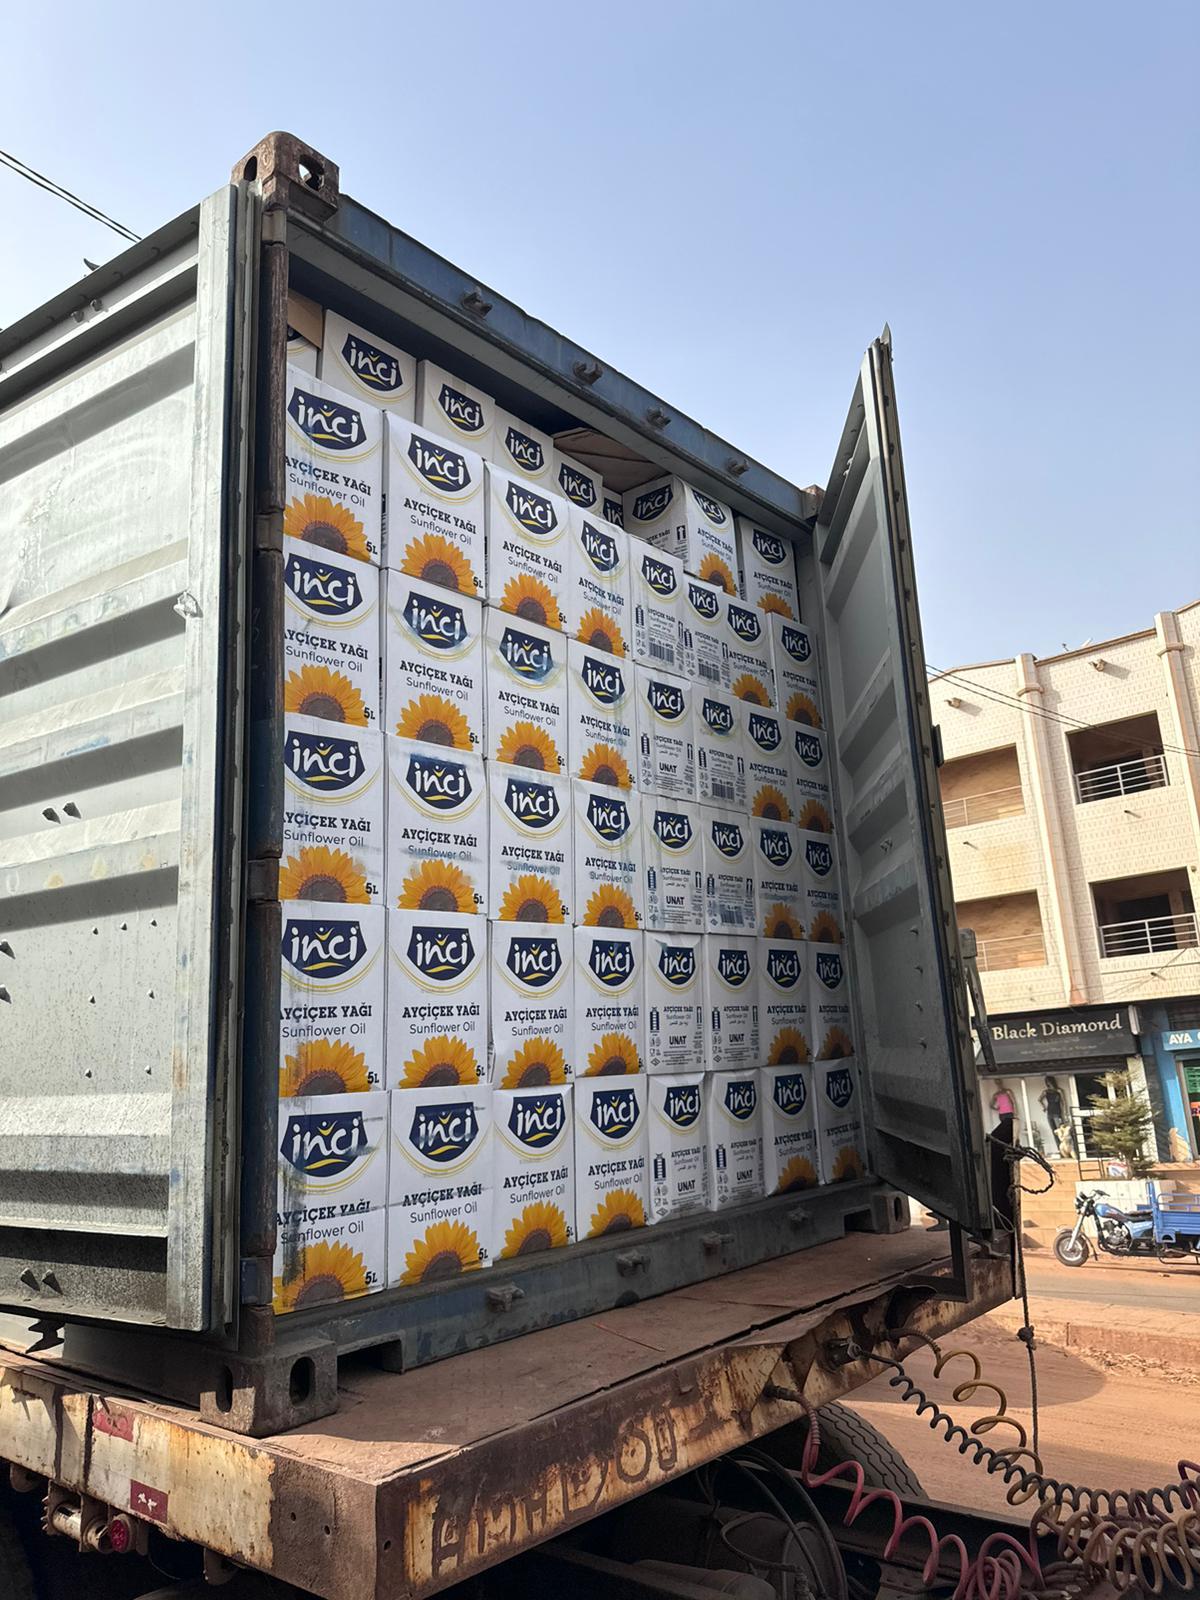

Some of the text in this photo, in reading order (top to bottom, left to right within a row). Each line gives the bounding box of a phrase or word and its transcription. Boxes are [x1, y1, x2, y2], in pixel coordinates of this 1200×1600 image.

[350, 341, 396, 386] inci
[298, 396, 359, 443] inci
[444, 390, 479, 427] inci
[510, 433, 540, 466] inci
[416, 441, 464, 484] inci
[290, 473, 365, 507] Sunflower Oil
[343, 477, 371, 496] YAĞI
[563, 469, 593, 502] inci
[404, 498, 476, 534] AYÇİÇEK YAĞI
[512, 488, 552, 527] inci
[411, 514, 471, 545] Sunflower Oil
[366, 541, 377, 554] 5L
[503, 541, 562, 573] AYÇİÇEK YAĞI
[585, 528, 614, 568] inci
[508, 556, 558, 583] Sunflower Oil
[646, 562, 674, 590] inci
[293, 561, 354, 606] inci
[473, 577, 483, 588] 5L
[692, 584, 716, 613] inci
[412, 599, 461, 640] inci
[559, 613, 567, 623] 5L
[731, 608, 759, 637] inci
[340, 640, 368, 659] YAĞI
[507, 635, 547, 670] inci
[784, 631, 809, 656] inci
[285, 645, 362, 672] Sunflower Oil
[400, 660, 473, 689] AYÇİÇEK YAĞI
[587, 663, 619, 695] inci
[407, 677, 468, 700] Sunflower Oil
[652, 688, 681, 712] inci
[364, 708, 375, 720] 5L
[498, 691, 559, 715] AYÇİÇEK YAĞI
[504, 706, 556, 727] Sunflower Oil
[580, 715, 611, 732] AYÇİÇEK
[705, 703, 730, 727] inci
[469, 733, 479, 744] 5L
[586, 729, 616, 745] Sunflower
[752, 718, 777, 742] inci
[293, 739, 357, 777] inci
[797, 736, 820, 759] inci
[415, 762, 464, 797] inci
[511, 785, 553, 816] inci
[284, 811, 370, 832] YÇİÇEK YAĞI
[593, 801, 625, 830] inci
[284, 829, 364, 847] Sunflower Oil
[402, 828, 477, 847] AYÇİÇEK YAĞI
[658, 816, 688, 839] inci
[714, 827, 740, 849] inci
[459, 850, 471, 860] Oil
[502, 846, 564, 862] AYÇİÇEK YAĞI
[763, 835, 788, 857] inci
[809, 845, 830, 866] inci
[585, 857, 617, 872] AYÇİÇEK
[366, 883, 378, 894] 5L
[473, 894, 483, 904] 5L
[562, 906, 569, 915] 5L
[291, 926, 358, 963] inci
[416, 933, 467, 966] inci
[514, 943, 556, 974] inci
[596, 946, 629, 974] inci
[664, 952, 692, 974] inci
[722, 954, 747, 975] inci
[771, 954, 797, 977] inci
[819, 957, 841, 978] inci
[342, 1002, 372, 1017] YAĞI
[402, 1003, 480, 1021] AYÇİÇEK YAĞI
[505, 1006, 567, 1024] AYÇİÇEK YAĞI
[586, 1004, 639, 1020] AYÇİÇEK YAĞI
[282, 1024, 365, 1037] Sunflower Oil
[410, 1022, 475, 1034] Sunflower Oil
[512, 1024, 563, 1036] Sunflower Oil
[592, 1021, 636, 1031] Sunflower Oil
[992, 1013, 1122, 1041] Black Diamond
[669, 1036, 686, 1045] UNAT
[1169, 1033, 1193, 1044] AYA
[367, 1072, 379, 1084] 5L
[476, 1065, 485, 1076] 5L
[564, 1064, 572, 1074] 5L
[670, 1088, 699, 1117] inci
[730, 1084, 754, 1111] inci
[777, 1077, 804, 1105] inci
[518, 1100, 561, 1136] inci
[596, 1093, 634, 1127] inci
[292, 1117, 359, 1163] inci
[419, 1108, 471, 1150] inci
[504, 1166, 568, 1188] AYÇİÇEK YAĞI
[588, 1156, 644, 1176] AYÇİÇEK YAĞI
[595, 1173, 642, 1190] Sunflower Oil
[678, 1180, 695, 1192] UNAT
[403, 1182, 481, 1208] AYÇİÇEK YAĞI
[510, 1184, 565, 1204] Sunflower Oil
[410, 1202, 477, 1224] Sunflower Oil
[349, 1221, 364, 1234] Oil
[478, 1248, 488, 1260] 5L
[365, 1272, 377, 1285] 5L
